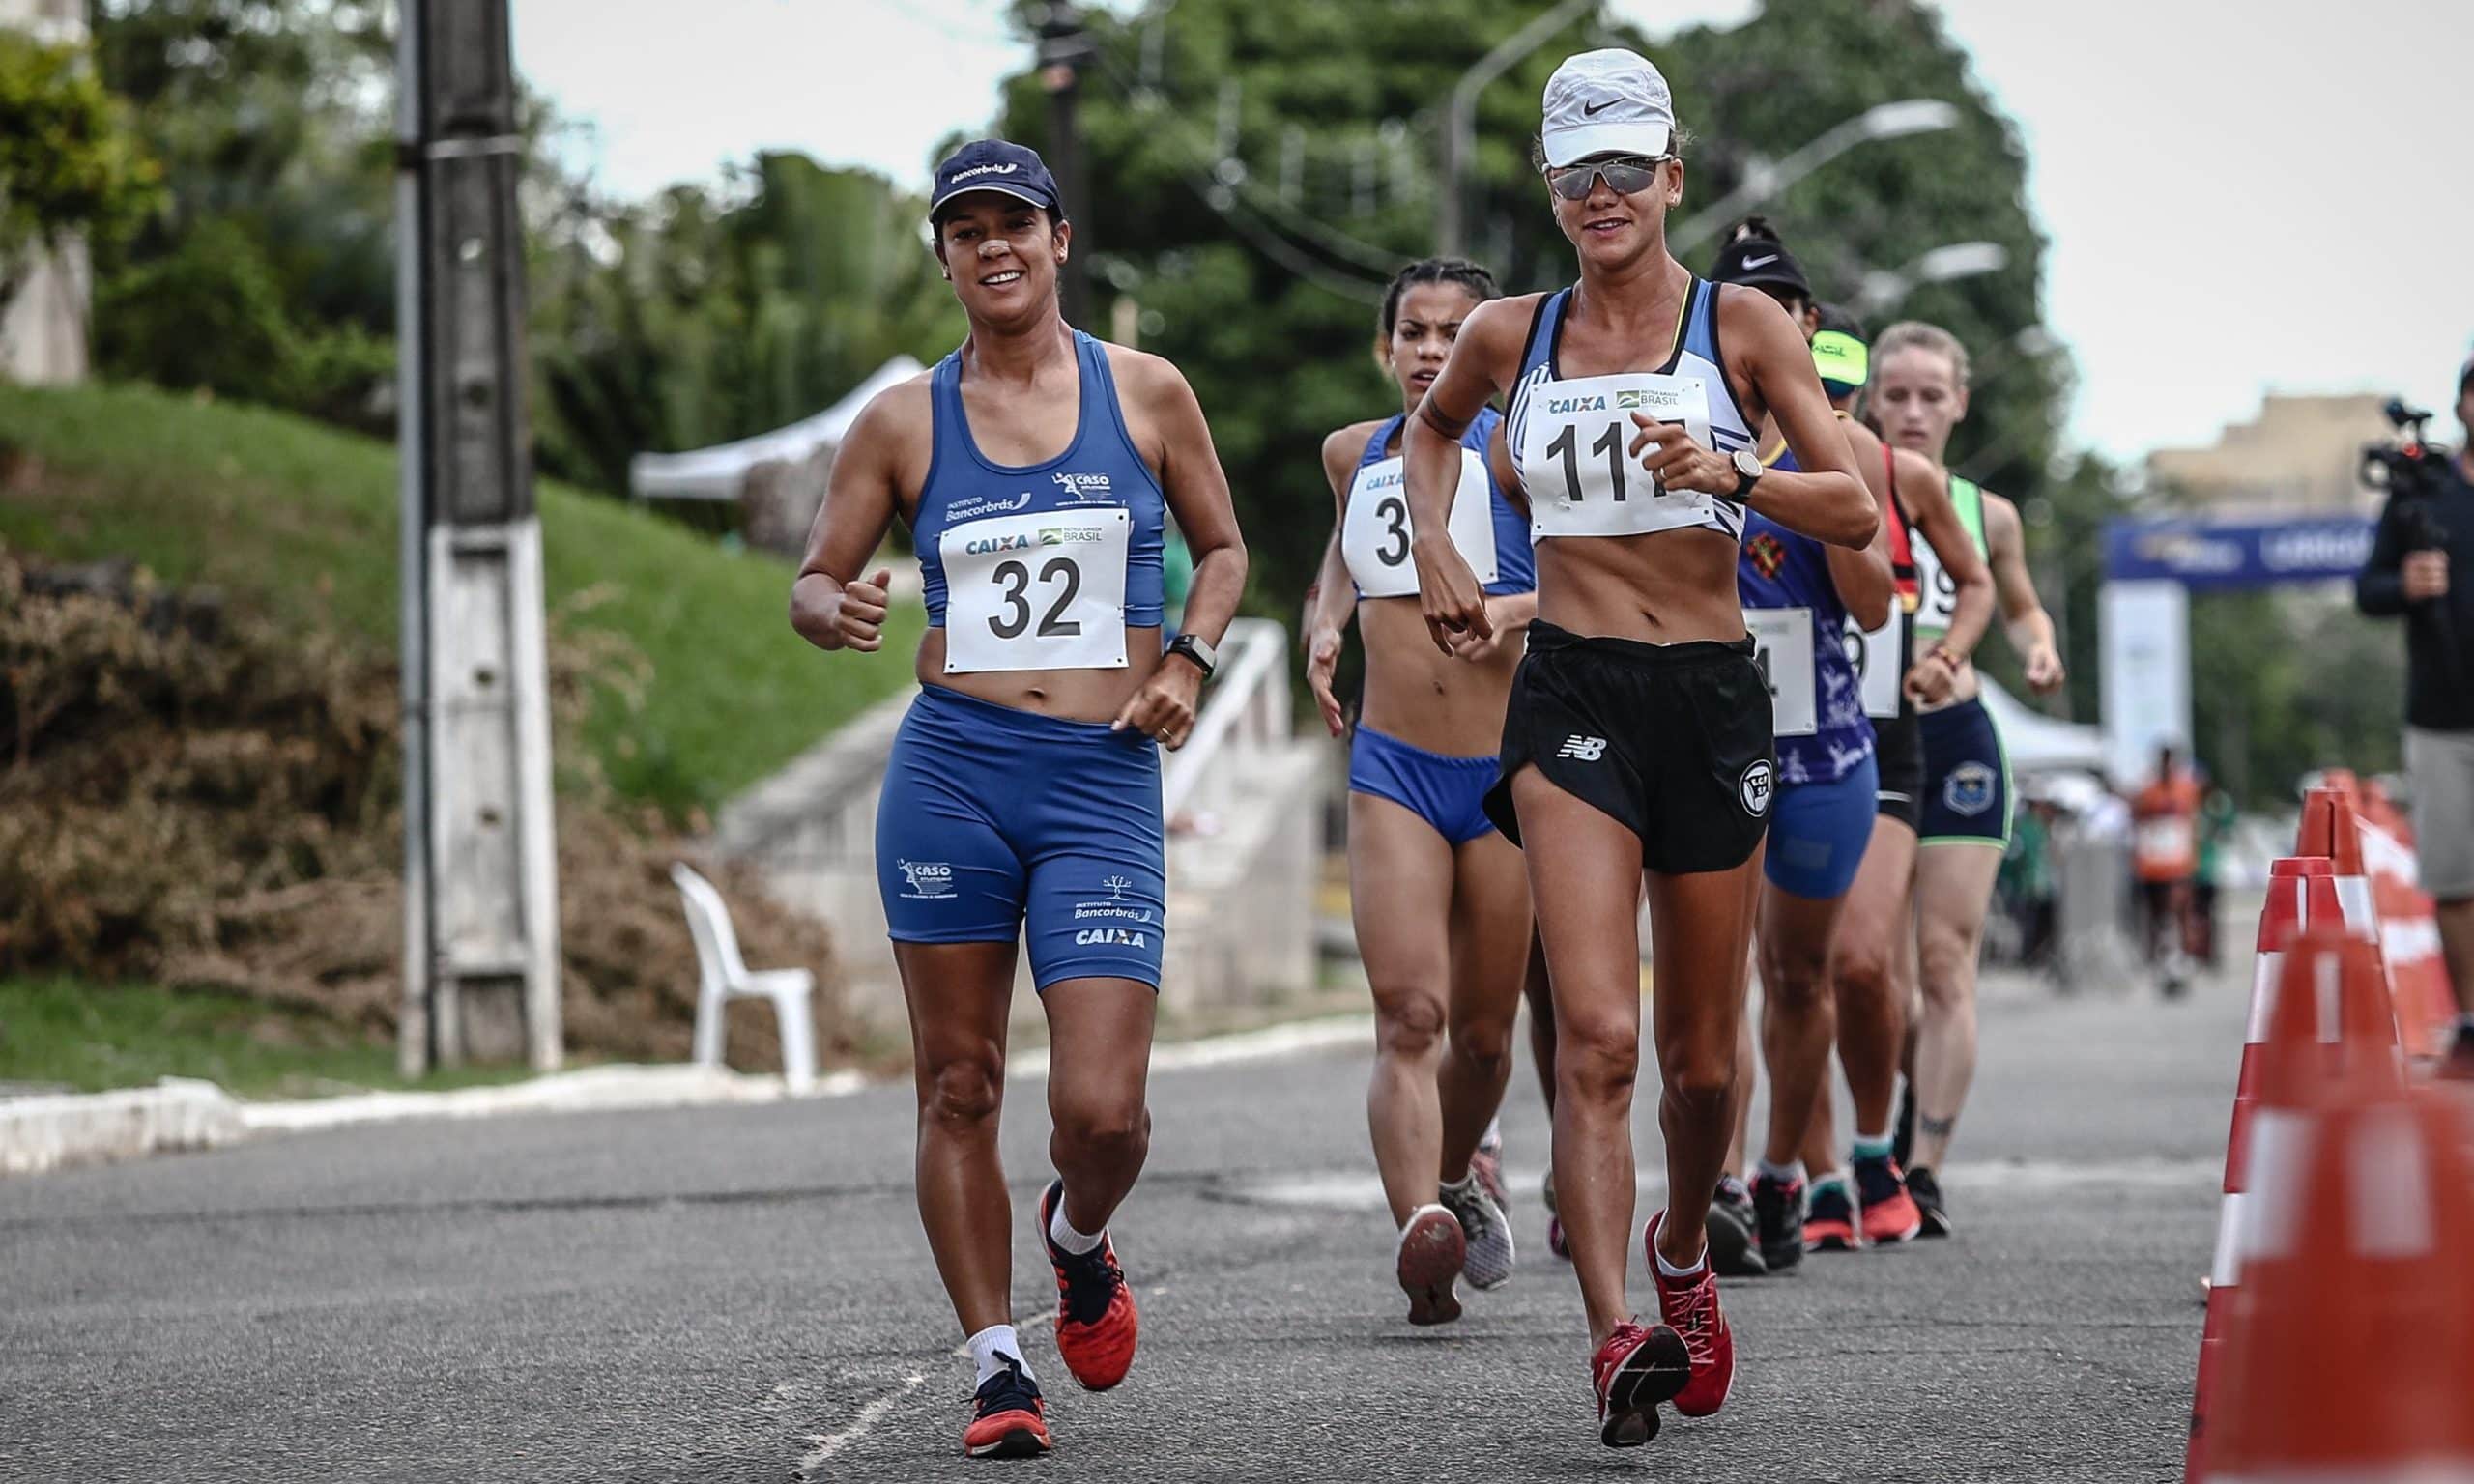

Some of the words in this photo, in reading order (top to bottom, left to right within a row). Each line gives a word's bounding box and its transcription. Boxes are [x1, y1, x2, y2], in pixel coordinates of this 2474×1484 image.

[1548, 396, 1606, 414] CAIXA
[1640, 395, 1679, 406] BRASIL
[1546, 419, 1685, 501] 11
[1076, 476, 1109, 485] CASO
[946, 499, 1013, 522] Bancorbrás
[966, 534, 1029, 555] CAIXA
[1063, 532, 1103, 542] BRASIL
[988, 557, 1081, 639] 32
[915, 866, 951, 876] CASO
[1075, 907, 1139, 920] Bancorbrás
[1075, 928, 1145, 948] CAIXA
